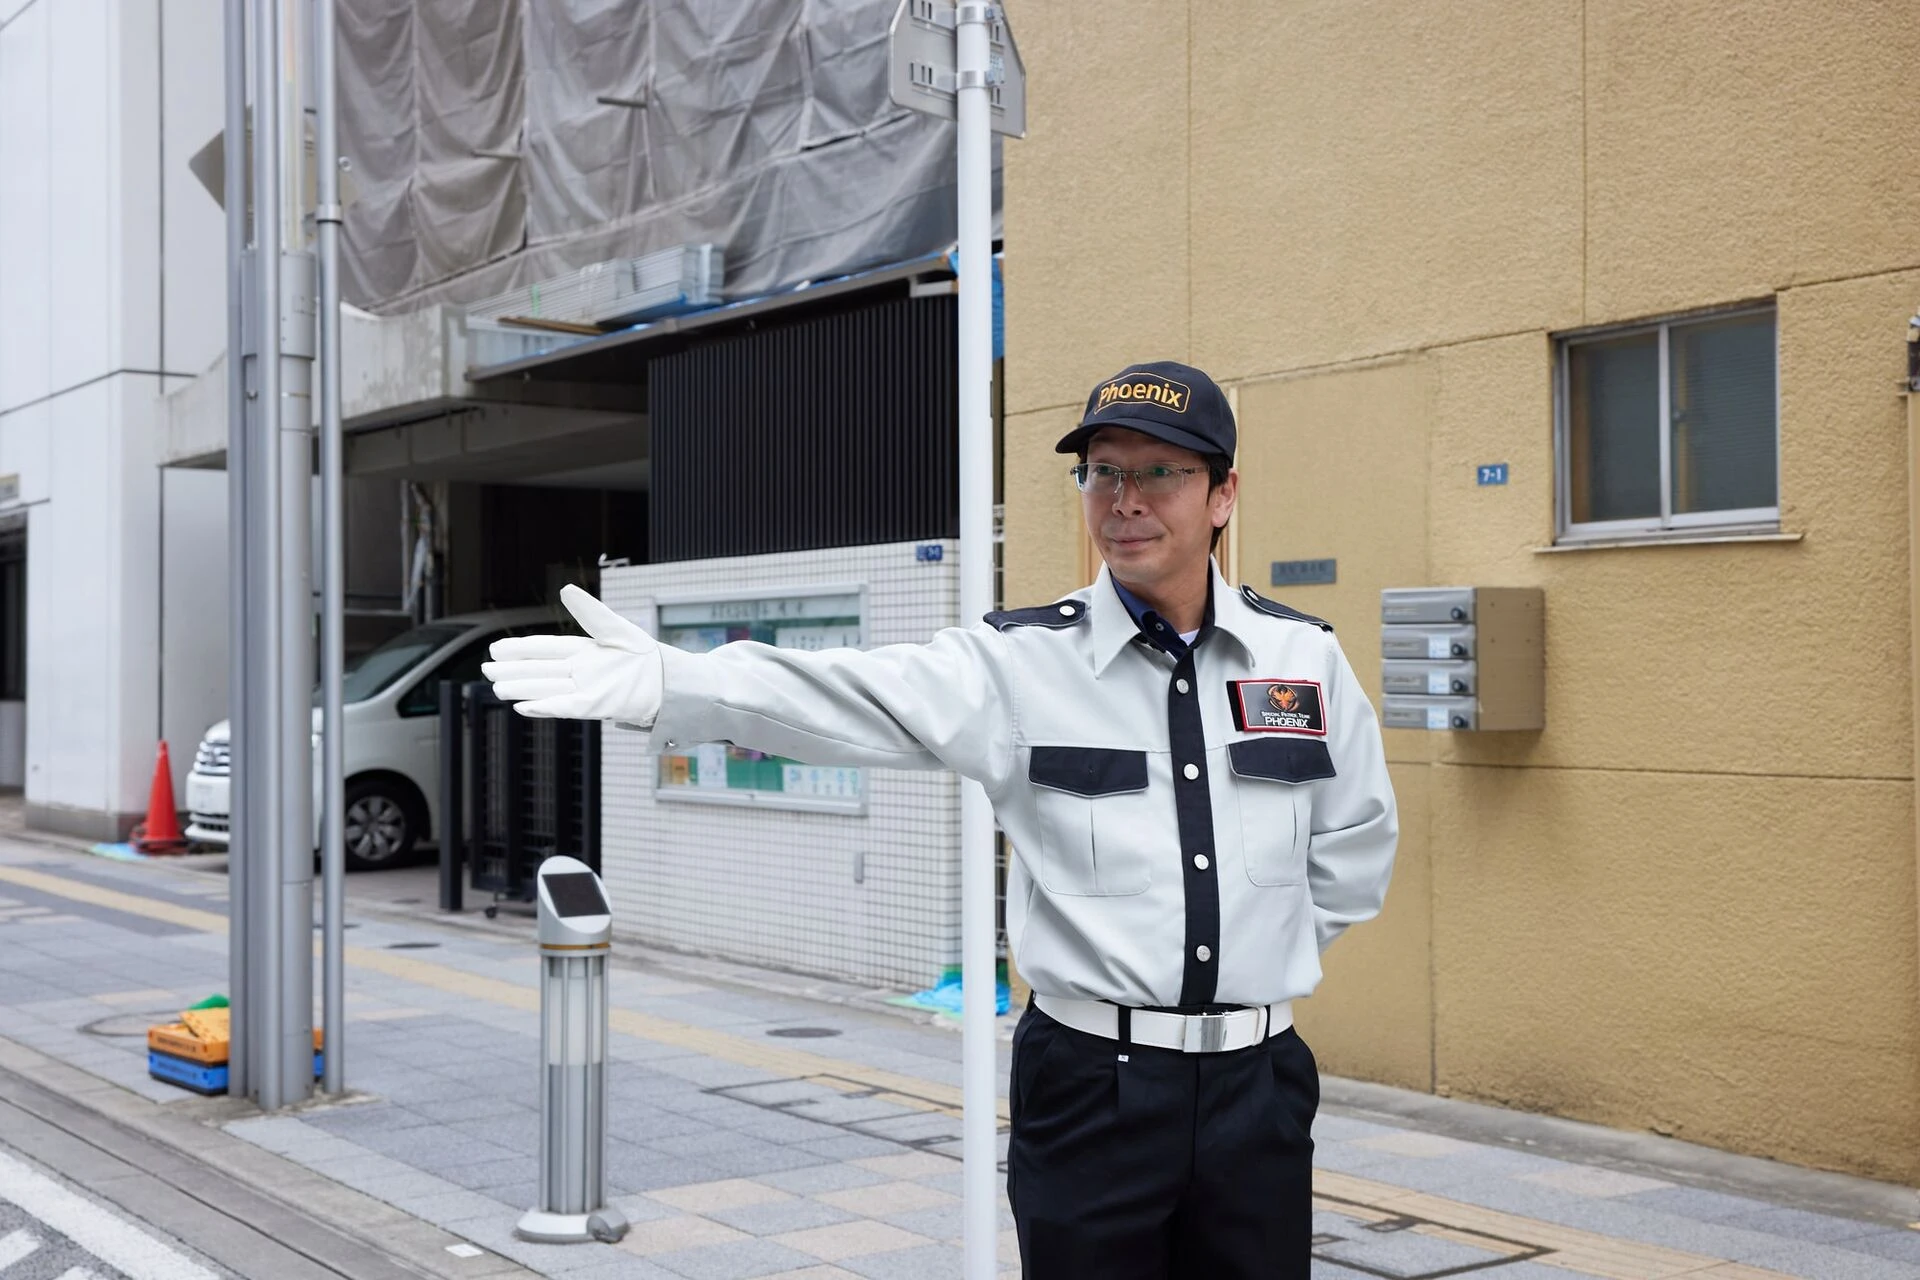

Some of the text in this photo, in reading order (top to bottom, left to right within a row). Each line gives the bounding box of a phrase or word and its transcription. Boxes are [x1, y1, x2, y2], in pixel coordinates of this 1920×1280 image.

[1098, 383, 1182, 408] Phoenix
[1482, 467, 1502, 482] 7-1
[1265, 716, 1308, 728] PHOENIX
